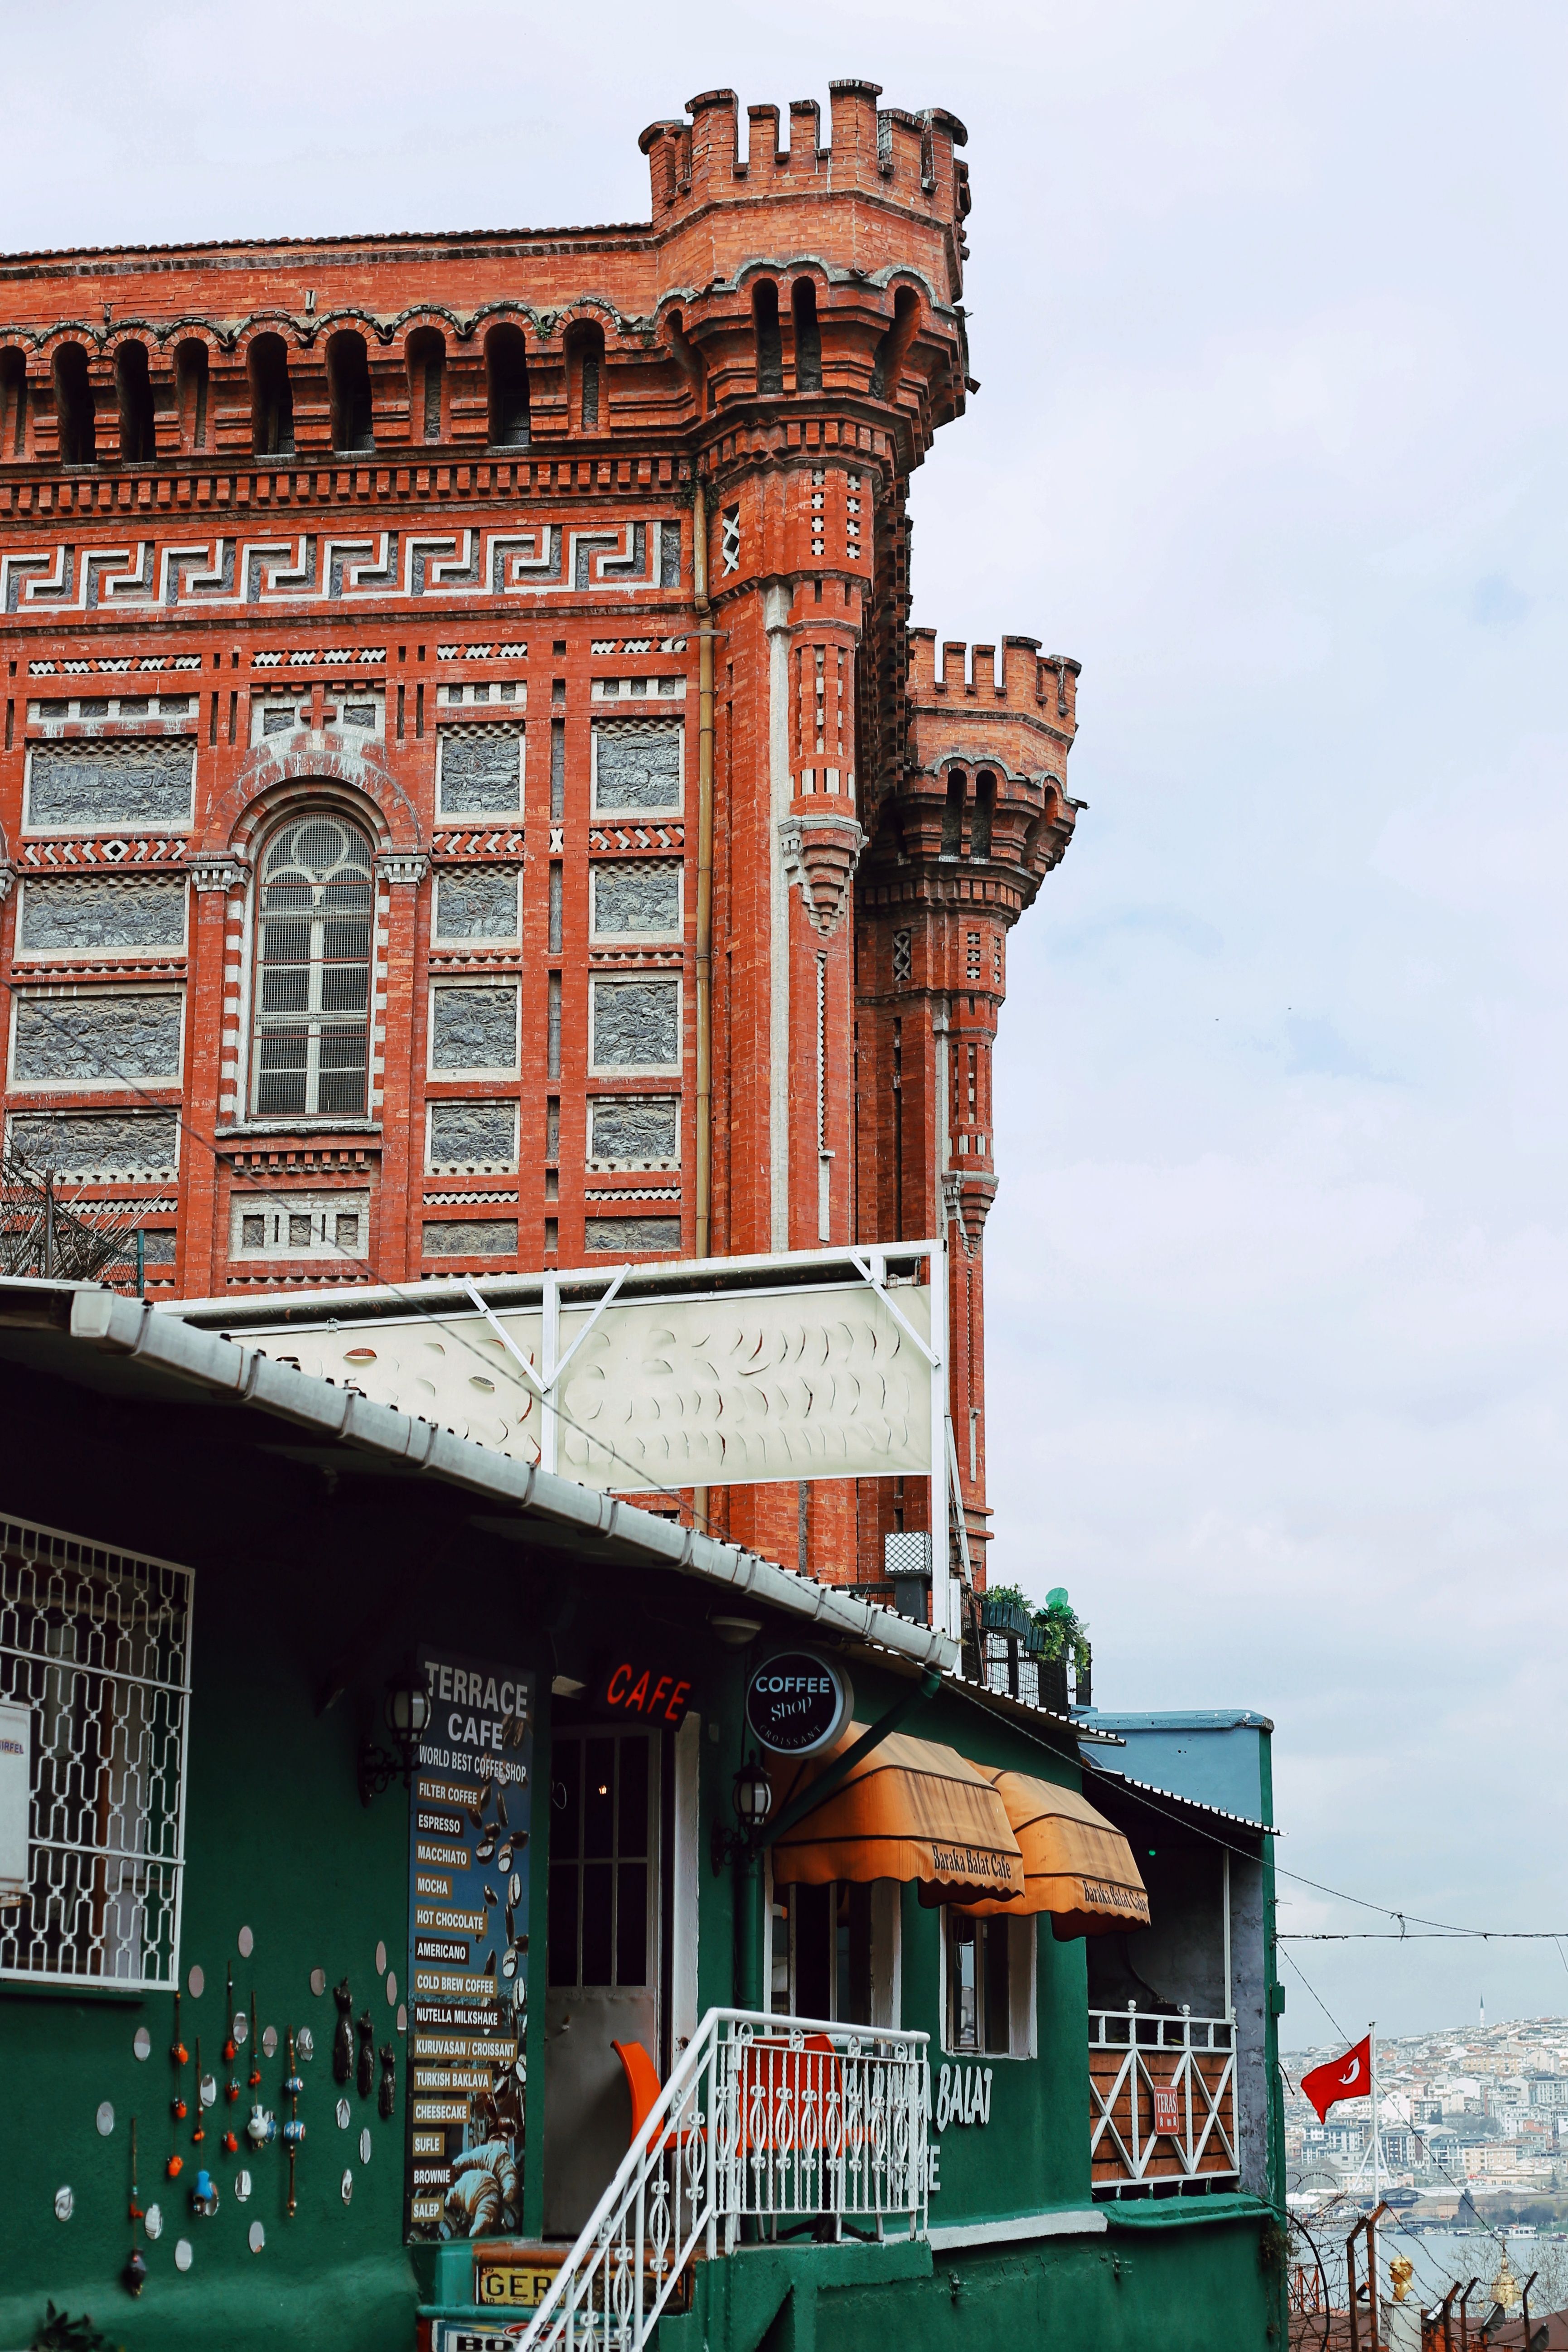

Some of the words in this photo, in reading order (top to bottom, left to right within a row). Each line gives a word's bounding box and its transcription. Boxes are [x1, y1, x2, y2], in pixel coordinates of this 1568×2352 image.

[425, 1661, 528, 1718] TERRACE
[607, 1664, 690, 1721] CAFE
[755, 1677, 830, 1693] COFFEE
[771, 1696, 812, 1722] Shop
[448, 1713, 503, 1750] CAFE
[760, 1724, 821, 1746] CROISSANT
[0, 1741, 24, 1754] IRFEL
[419, 1745, 449, 1768] WORLD
[452, 1752, 472, 1773] BEST
[474, 1757, 503, 1779] COFFEE
[505, 1763, 526, 1783] SHOP
[419, 1782, 446, 1800] FILTER
[448, 1787, 477, 1805] COFFEE
[418, 1815, 460, 1833] ESPRESSO
[418, 1845, 467, 1865] MACCHIATO
[932, 1845, 965, 1873] Baraka
[966, 1849, 990, 1876] Balat
[991, 1853, 1011, 1879] Cafe
[417, 1878, 448, 1895] MOCHA
[1082, 1880, 1112, 1904] Baraka
[1109, 1885, 1132, 1908] Balat
[1129, 1890, 1147, 1912] Cafe
[417, 1910, 434, 1926] HOT
[436, 1912, 483, 1930] CHOCOLATE
[417, 1942, 466, 1960] AMERICANO
[417, 1975, 439, 1990] COLD
[441, 1977, 463, 1992] BREW
[465, 1979, 494, 1994] COFFEE
[416, 2008, 452, 2023] NUTELLA
[454, 2010, 498, 2026] MILKSHAKE
[416, 2040, 466, 2056] KURUVASAN
[467, 2042, 470, 2056] /
[472, 2042, 515, 2058] CROISSANT
[416, 2072, 450, 2086] TURKISH
[452, 2073, 489, 2087] BAKLAVA
[936, 2063, 993, 2132] BALAT
[1157, 2093, 1176, 2113] TERAS
[415, 2105, 467, 2120] CHEESECAKE
[415, 2138, 439, 2152] SUFLE
[413, 2169, 450, 2184] BROWNIE
[413, 2203, 439, 2218] SALEP
